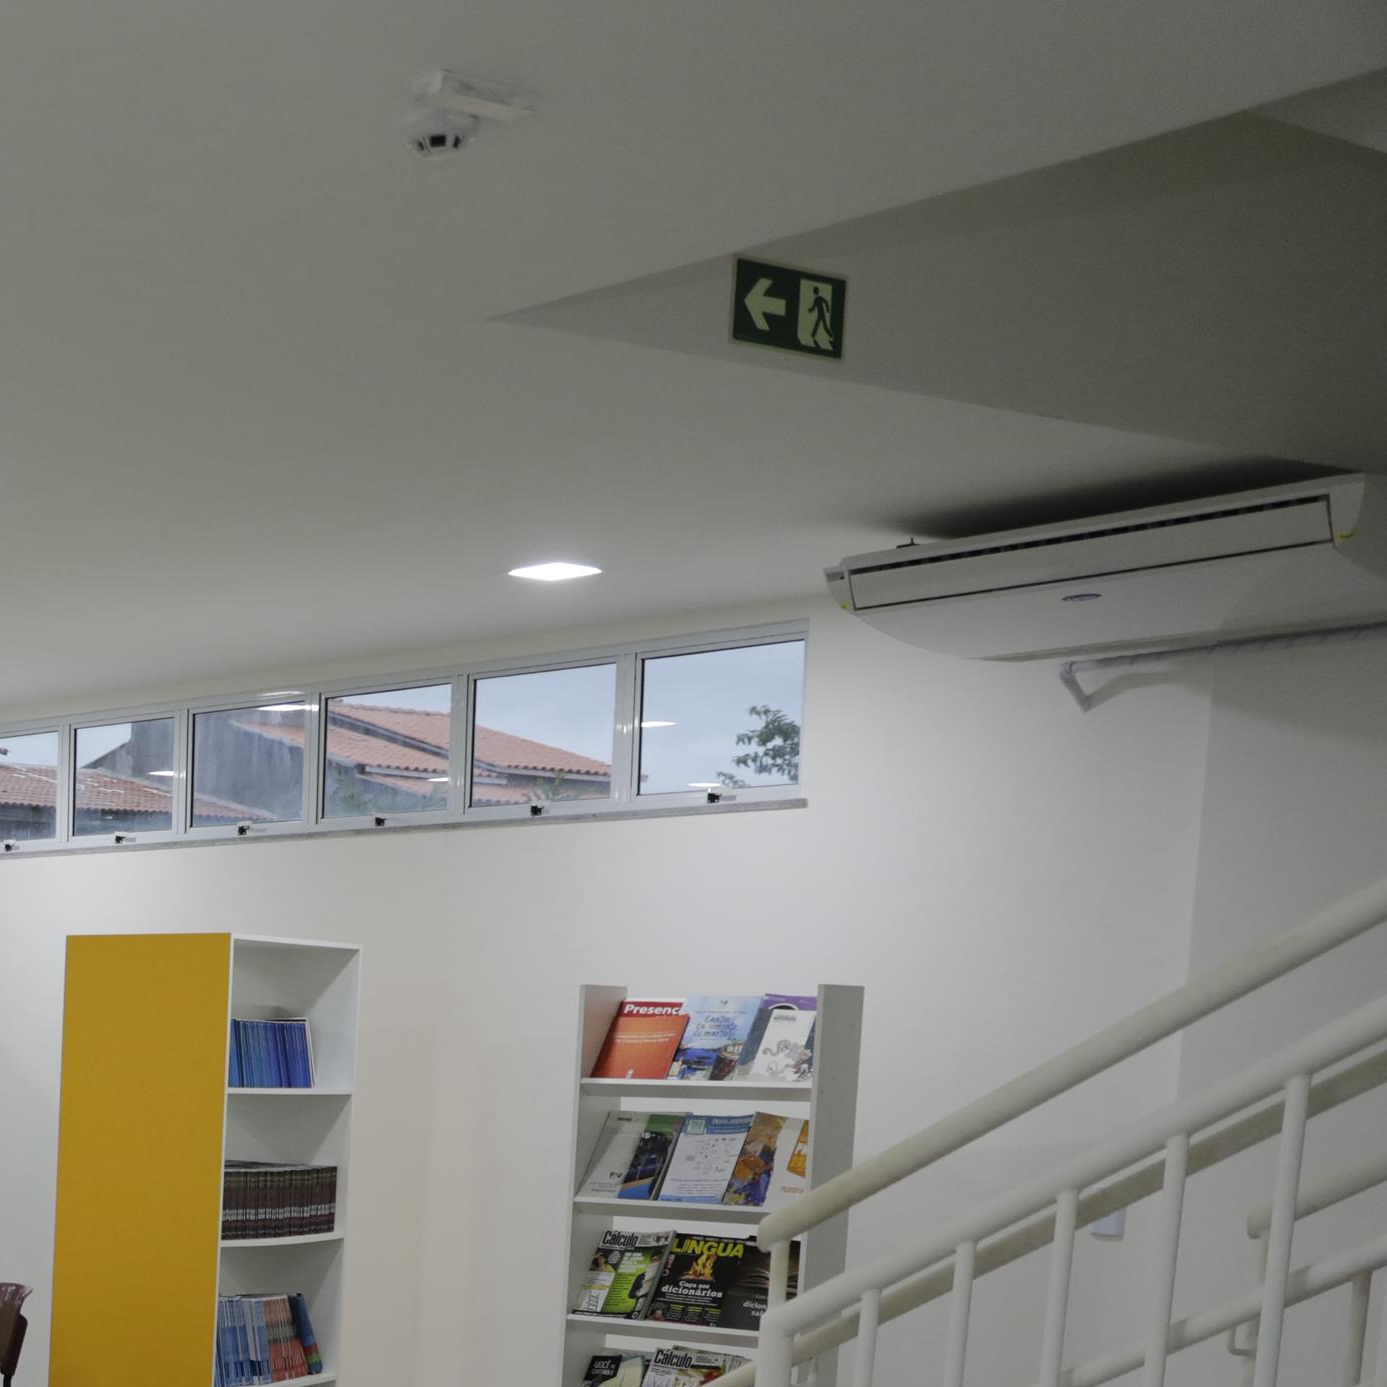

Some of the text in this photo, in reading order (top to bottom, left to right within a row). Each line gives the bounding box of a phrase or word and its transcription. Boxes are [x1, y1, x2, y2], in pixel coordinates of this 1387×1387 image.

[602, 1230, 639, 1247] Cálculo
[661, 1285, 724, 1298] dicionários
[742, 1300, 767, 1309] dicion
[654, 1348, 692, 1369] Cálculo
